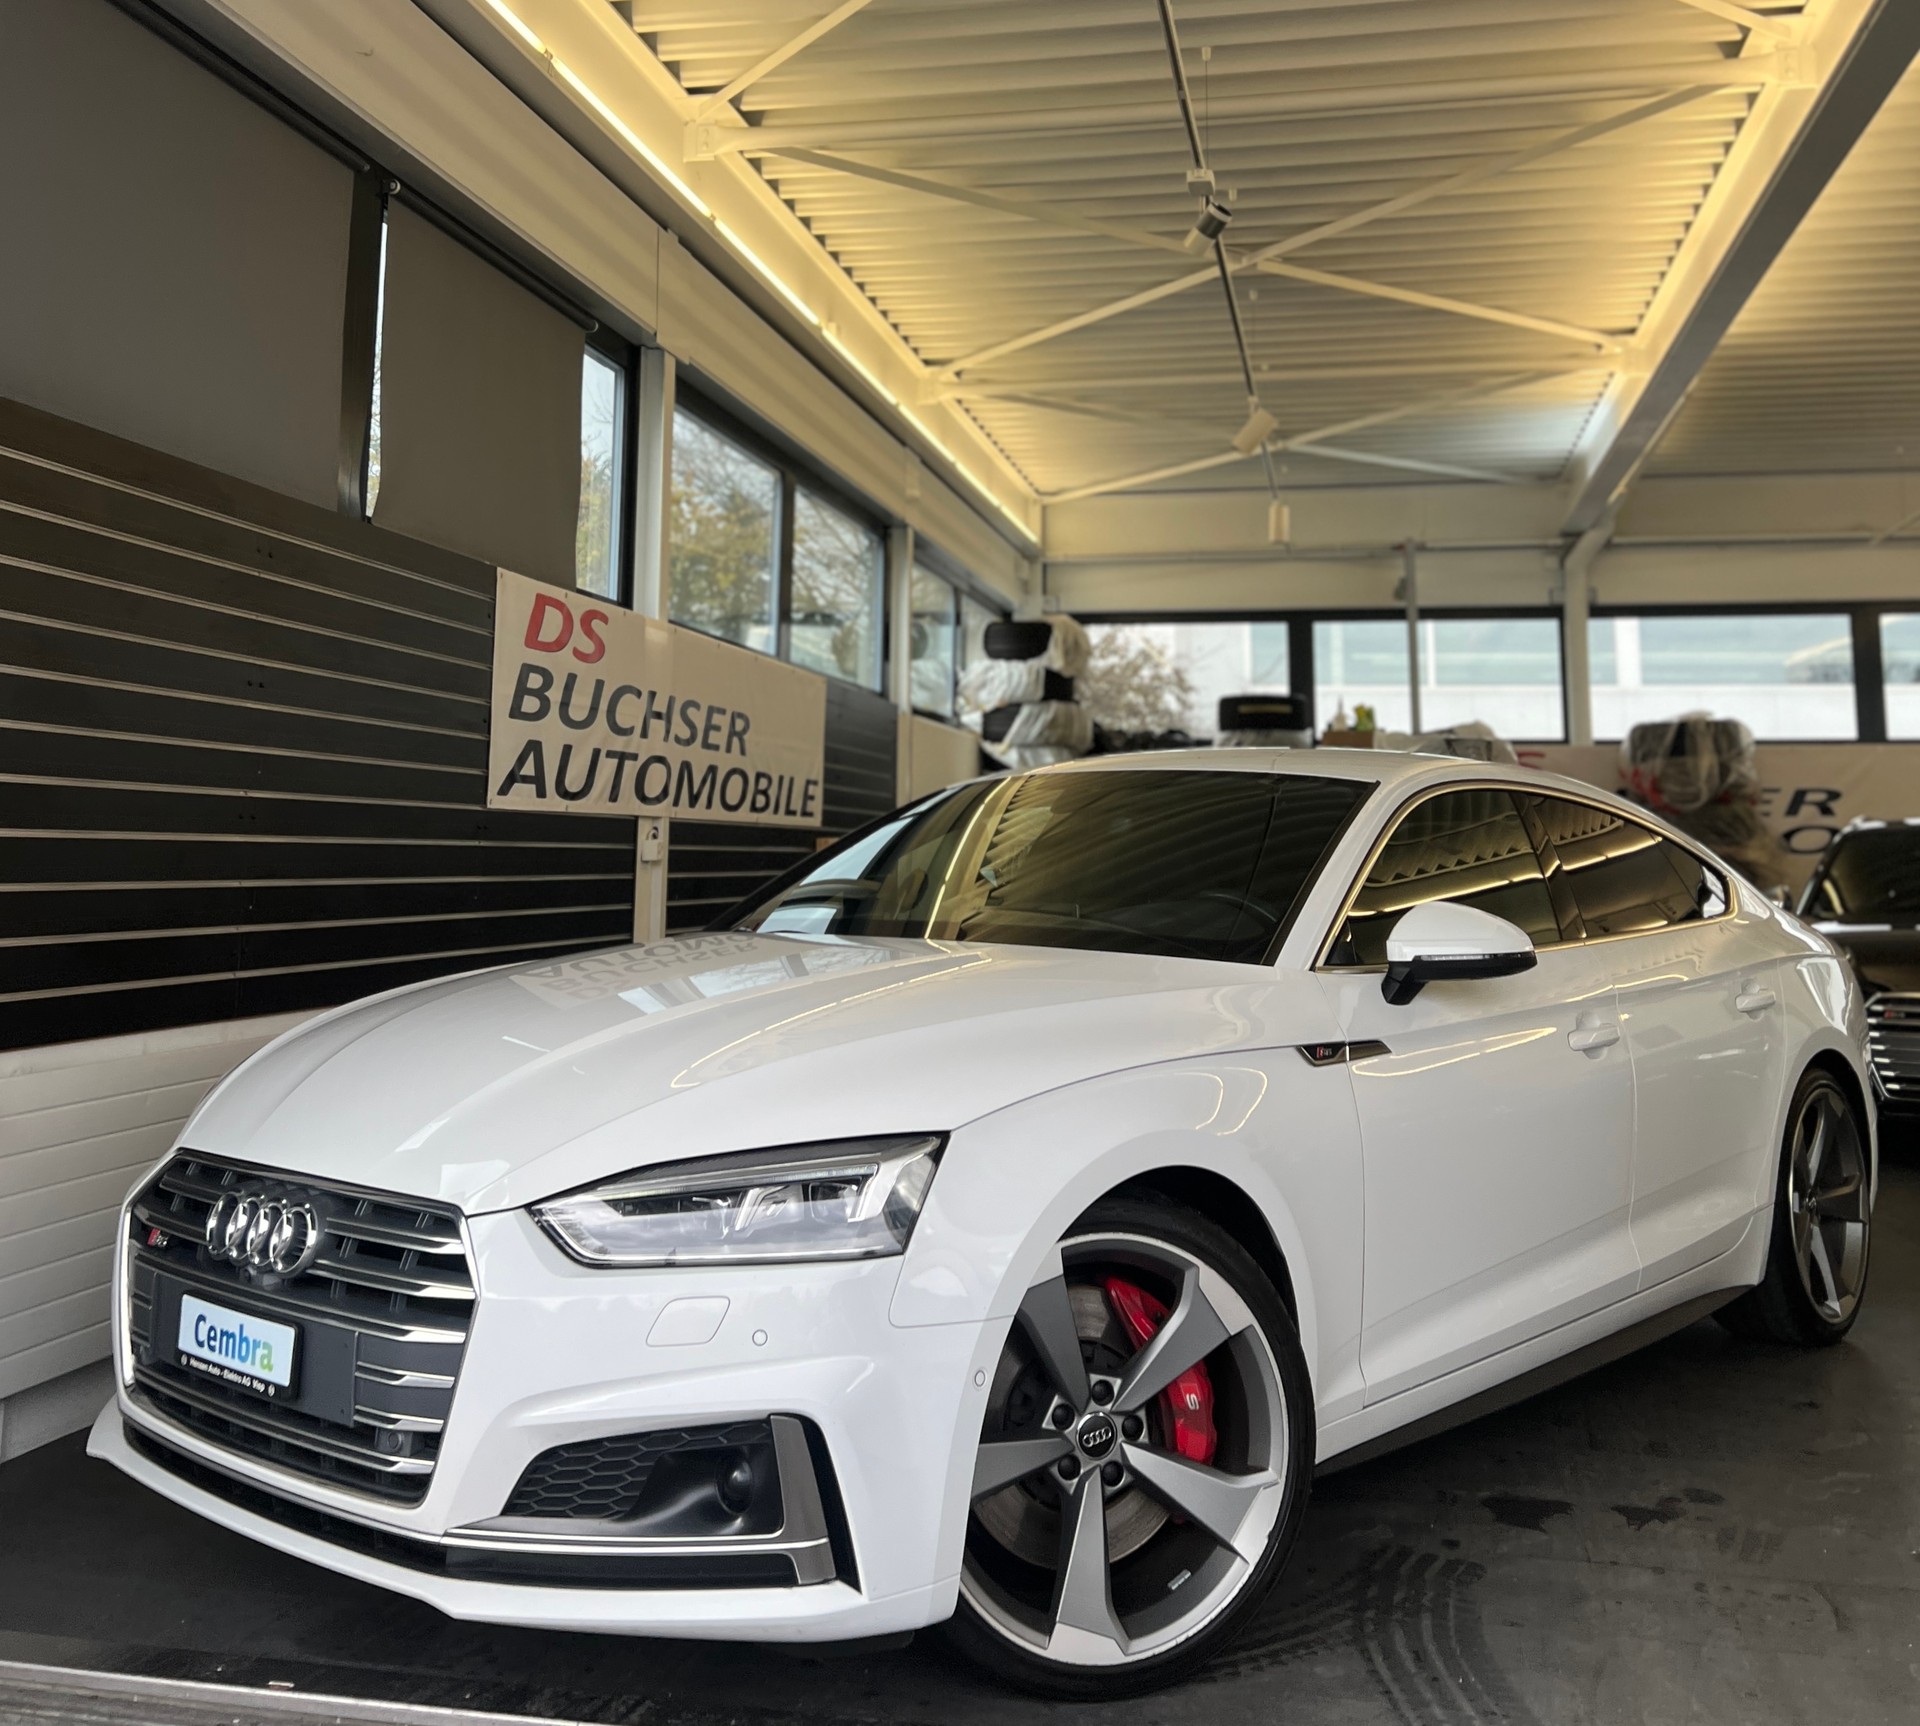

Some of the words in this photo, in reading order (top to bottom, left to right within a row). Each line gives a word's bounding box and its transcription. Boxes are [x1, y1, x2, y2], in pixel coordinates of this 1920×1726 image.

[524, 592, 609, 664] DS
[508, 662, 750, 757] BUCHSER
[497, 739, 819, 818] AUTOMOBILE
[194, 1313, 274, 1374] Cembra
